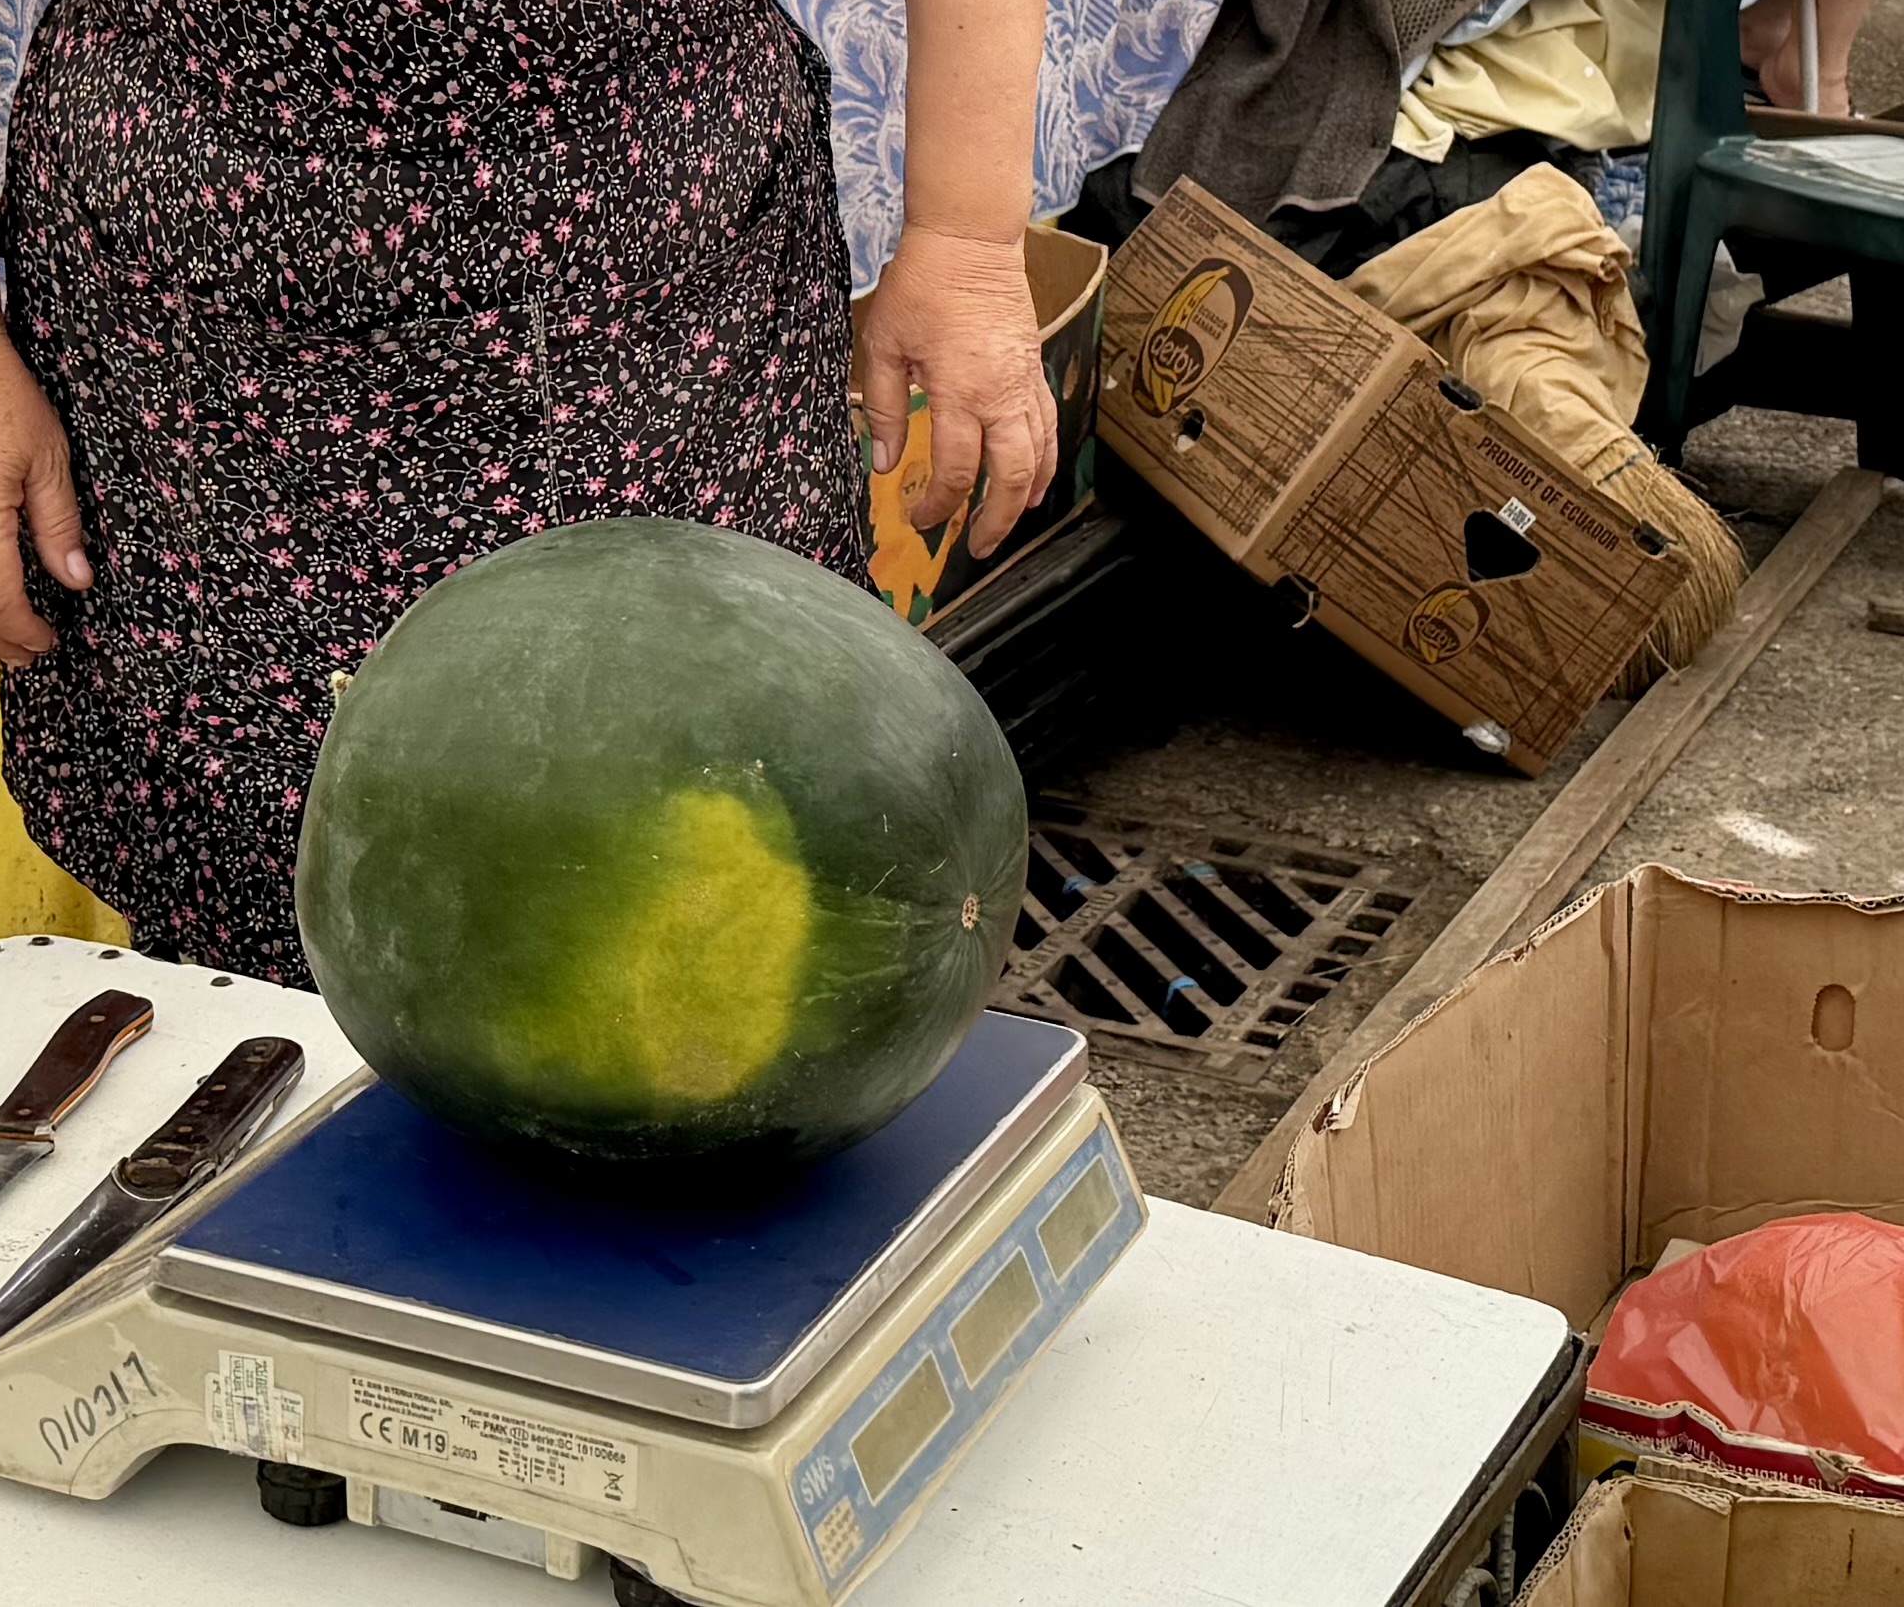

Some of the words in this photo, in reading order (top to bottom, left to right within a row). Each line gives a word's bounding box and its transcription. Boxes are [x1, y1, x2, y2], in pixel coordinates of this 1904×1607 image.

[1151, 333, 1200, 385] derby
[1477, 436, 1544, 492] PRODUCT
[1541, 484, 1565, 506] OF
[1559, 500, 1621, 552] ECUADOR
[800, 1454, 835, 1506] SWS
